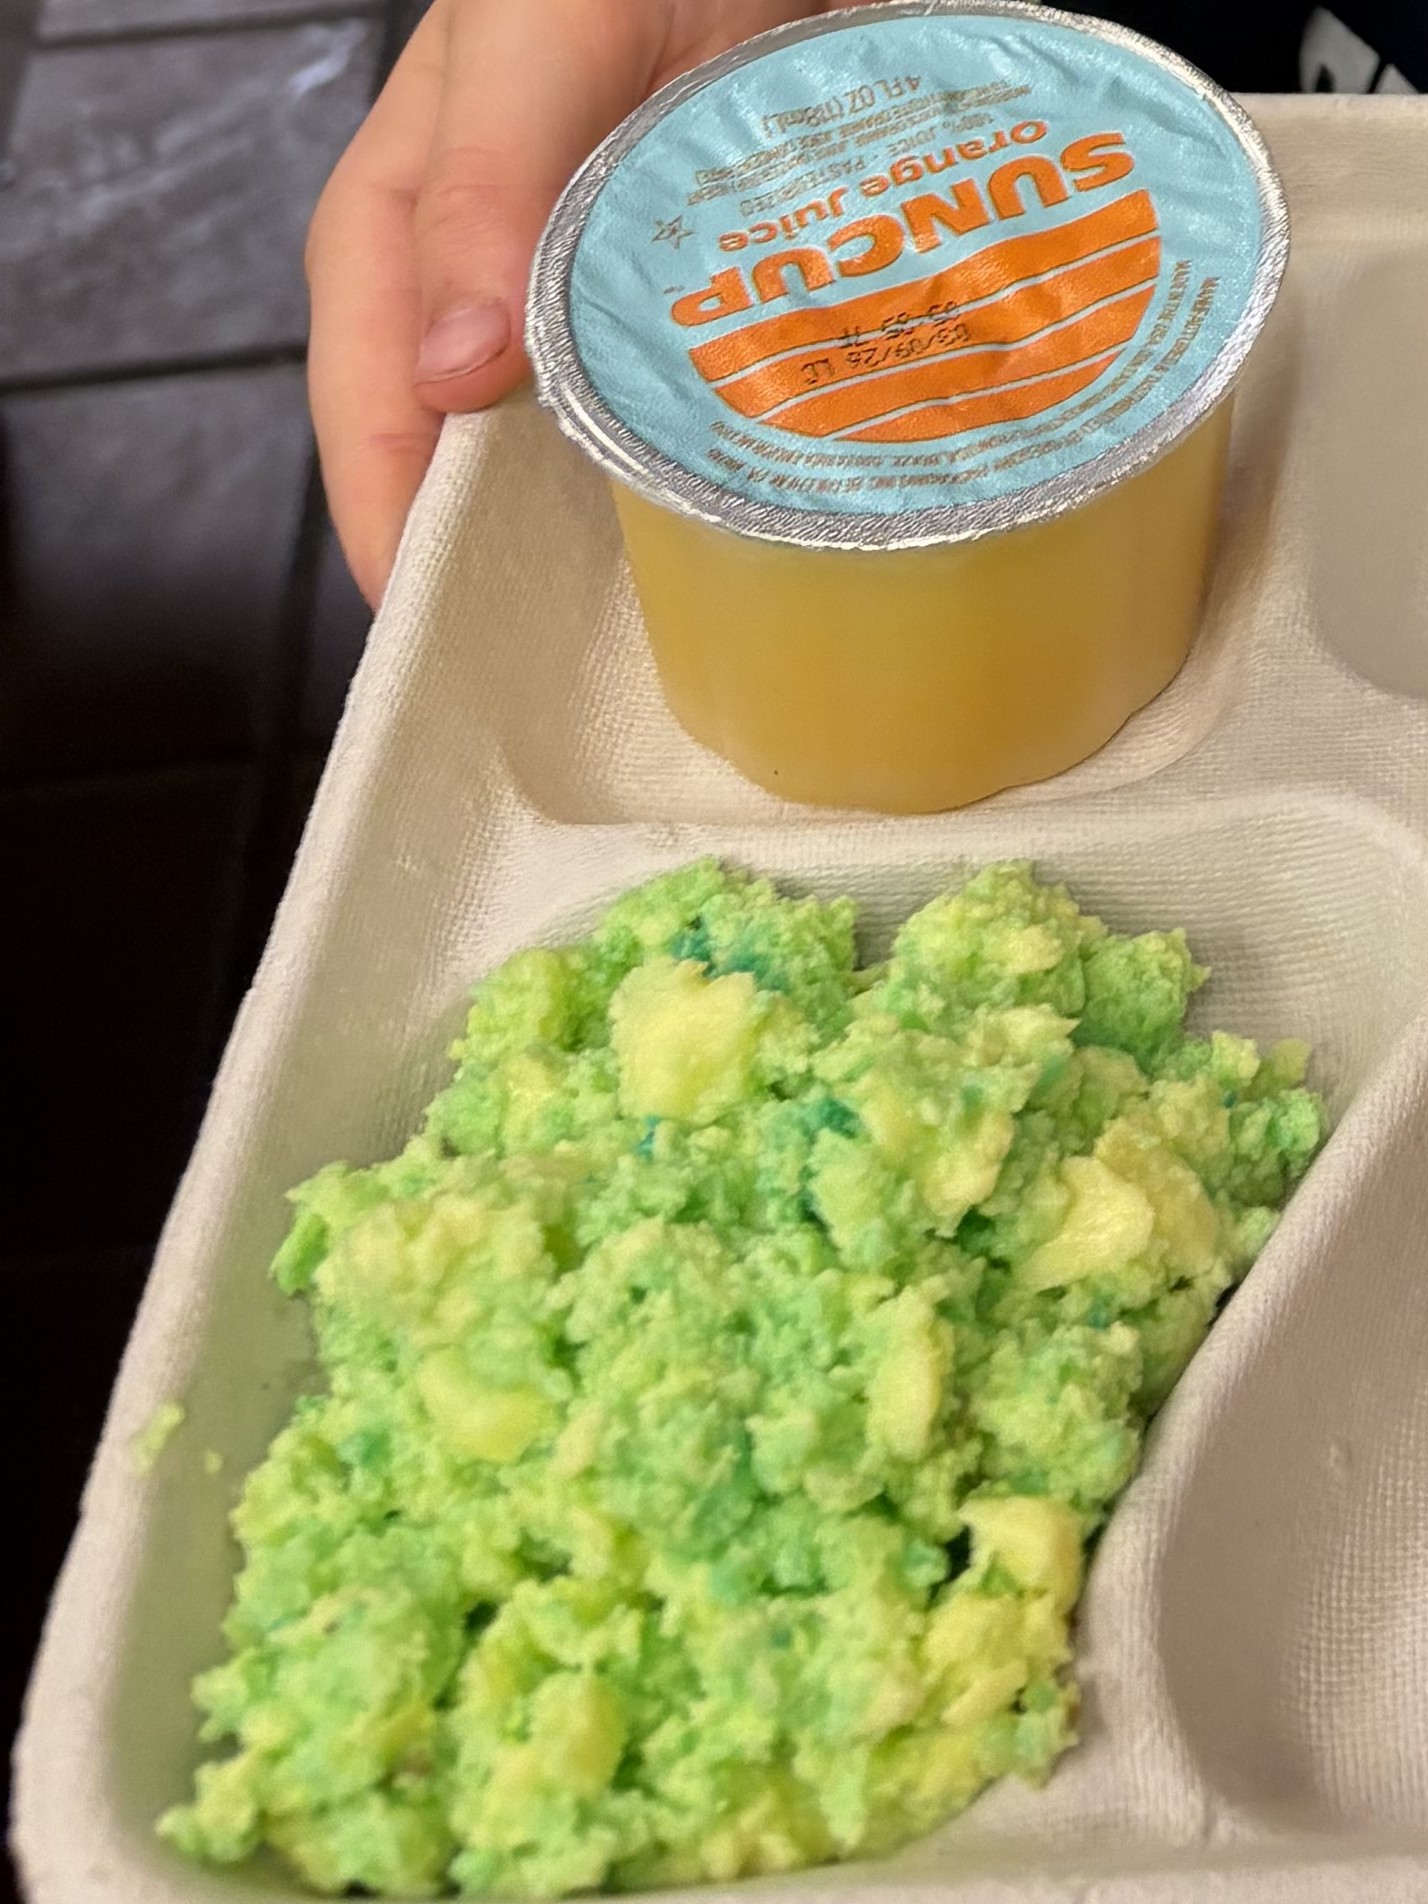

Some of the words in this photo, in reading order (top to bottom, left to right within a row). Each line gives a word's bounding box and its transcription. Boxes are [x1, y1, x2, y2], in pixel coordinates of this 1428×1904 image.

[858, 120, 1049, 198] Orange
[671, 132, 1135, 328] SUNCUP
[717, 186, 849, 254] Juice
